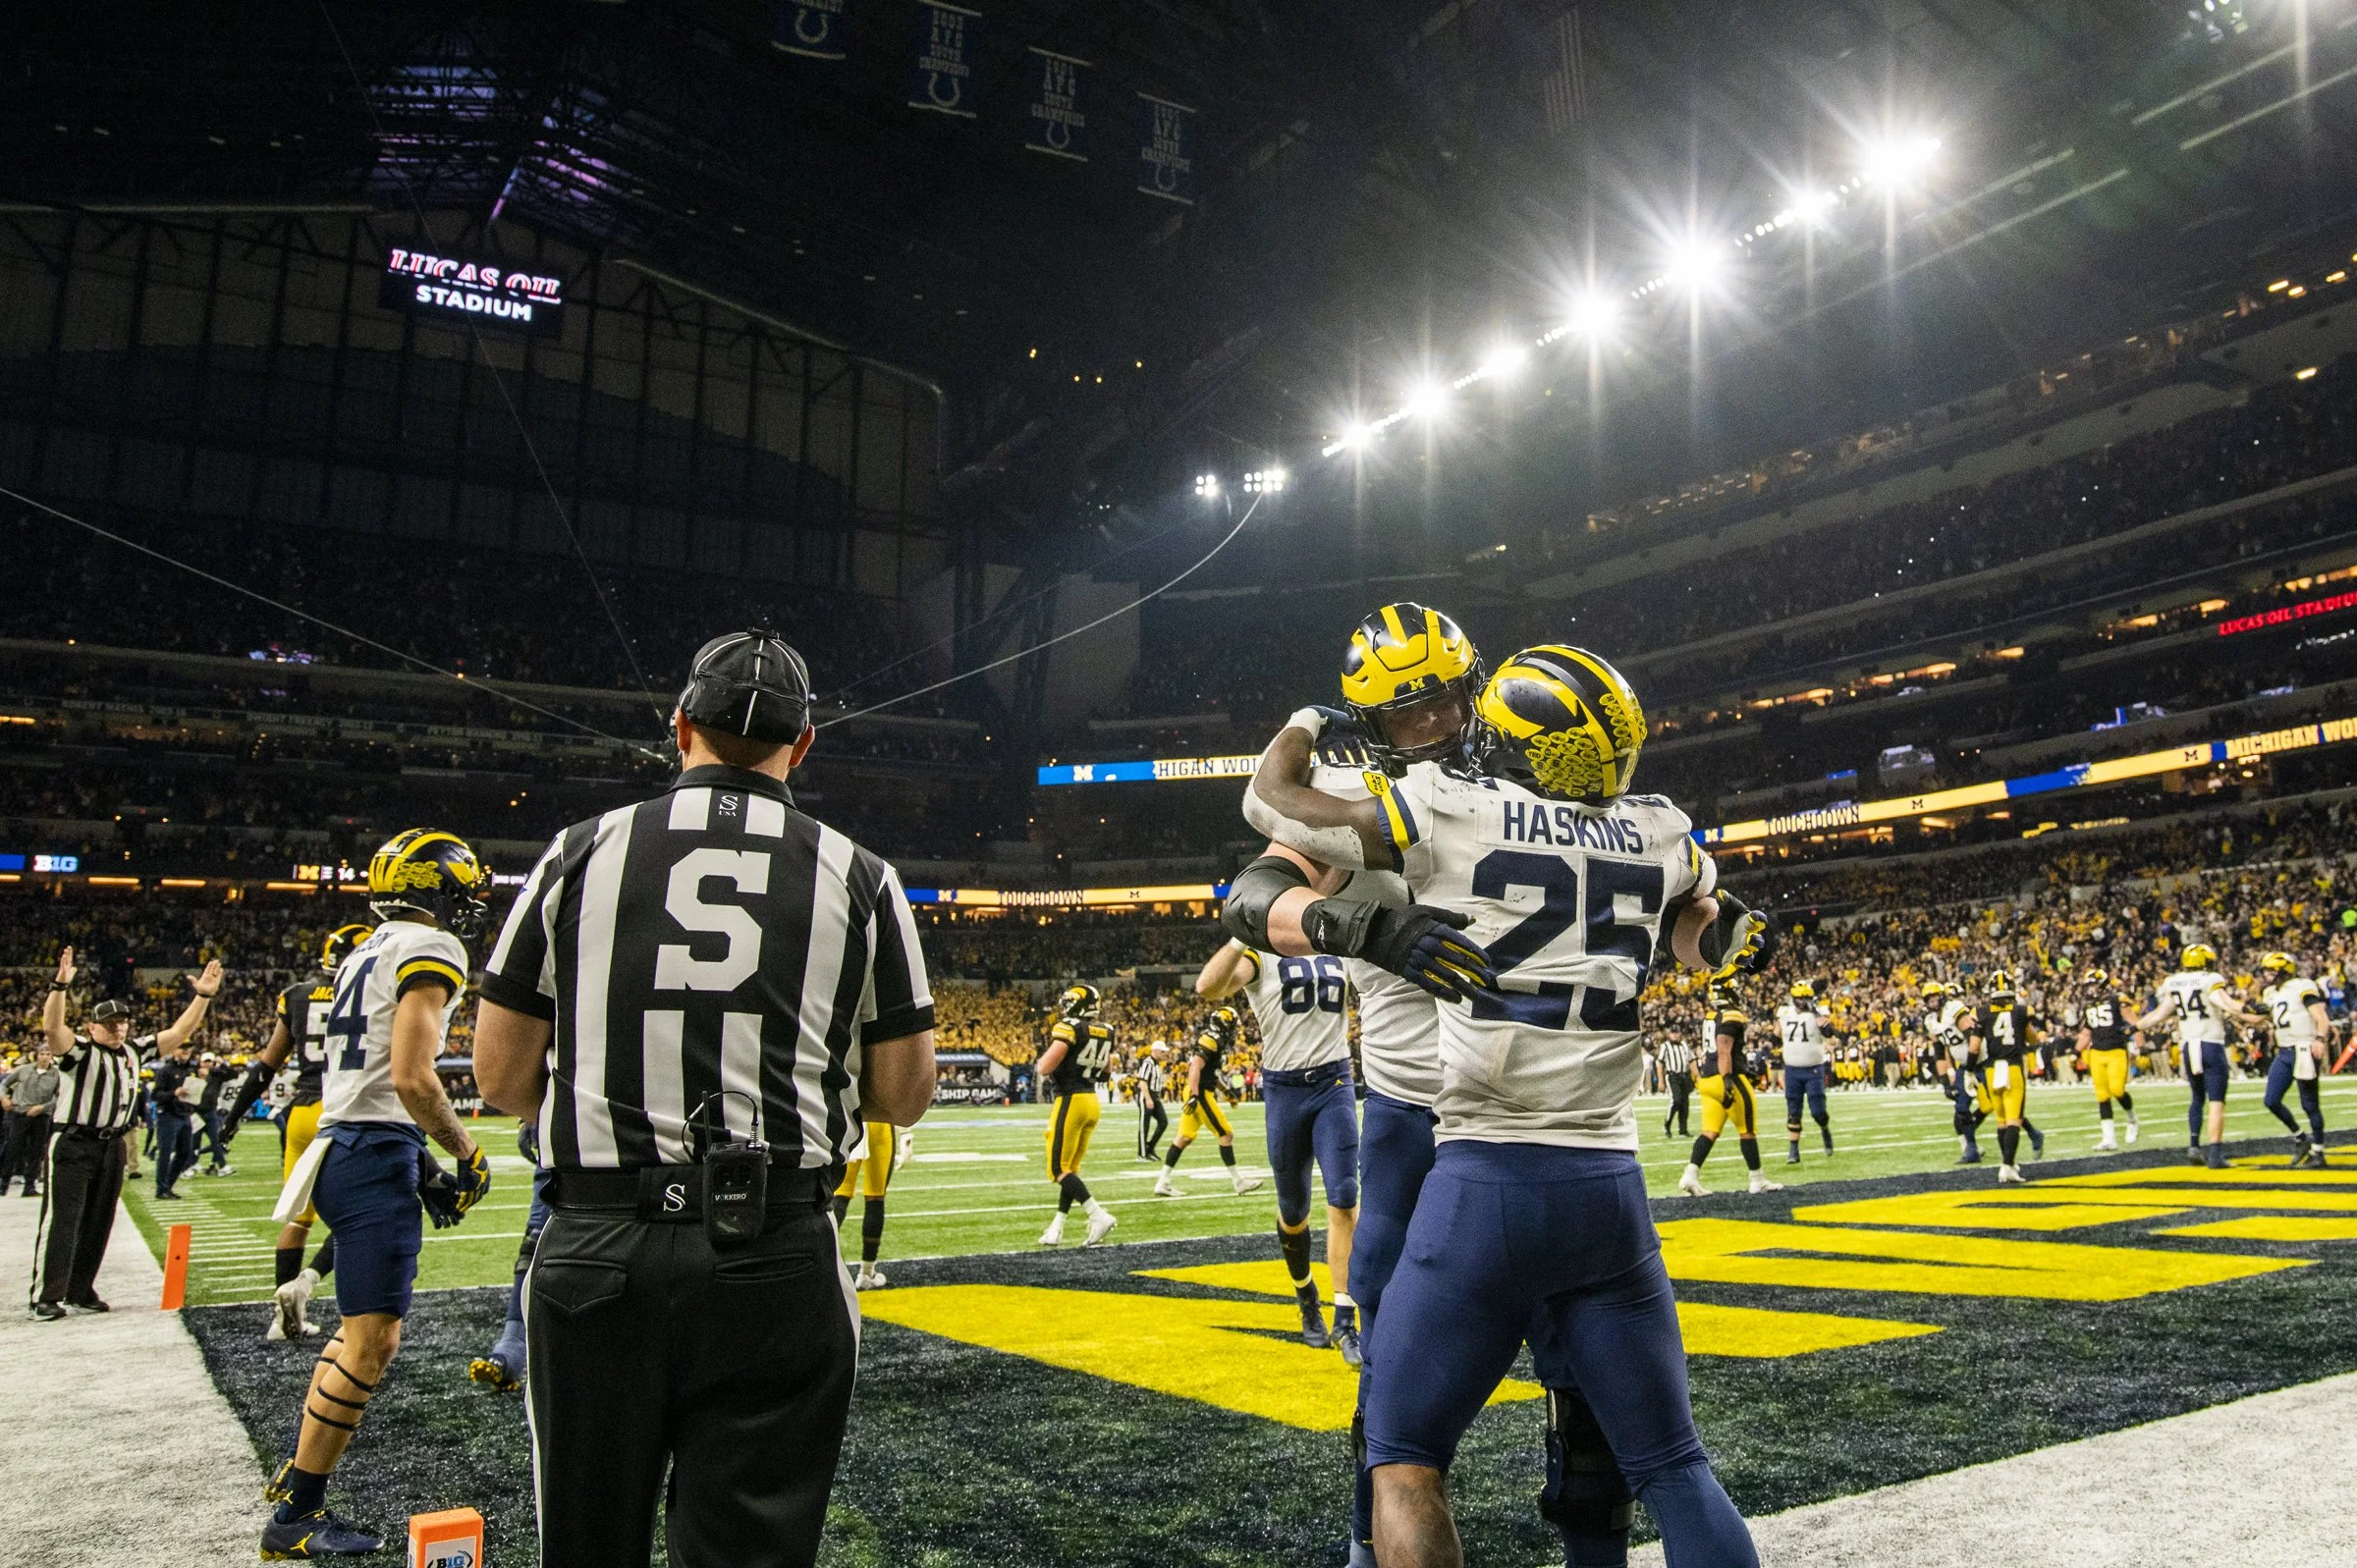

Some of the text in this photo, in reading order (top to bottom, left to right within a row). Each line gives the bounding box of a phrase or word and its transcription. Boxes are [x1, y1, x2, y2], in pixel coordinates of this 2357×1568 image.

[388, 248, 561, 304] LUCAS OIL
[415, 285, 532, 322] STADIUM
[2220, 591, 2357, 636] LUCAS OIL STADIU
[2225, 725, 2320, 760] MICHIGAN
[1159, 759, 1215, 777] HIGAN
[1504, 800, 1644, 855] HASKINS
[336, 867, 356, 881] 14
[653, 847, 772, 992] S
[1471, 848, 1665, 1032] 25
[1278, 956, 1345, 1015] 86
[1786, 1021, 1809, 1043] 71
[1993, 1011, 2015, 1045] 4
[2086, 1003, 2113, 1029] 85
[1076, 1038, 1112, 1078] 44
[275, 1083, 285, 1098] 9
[941, 1088, 969, 1100] SHIP
[663, 1184, 685, 1212] S
